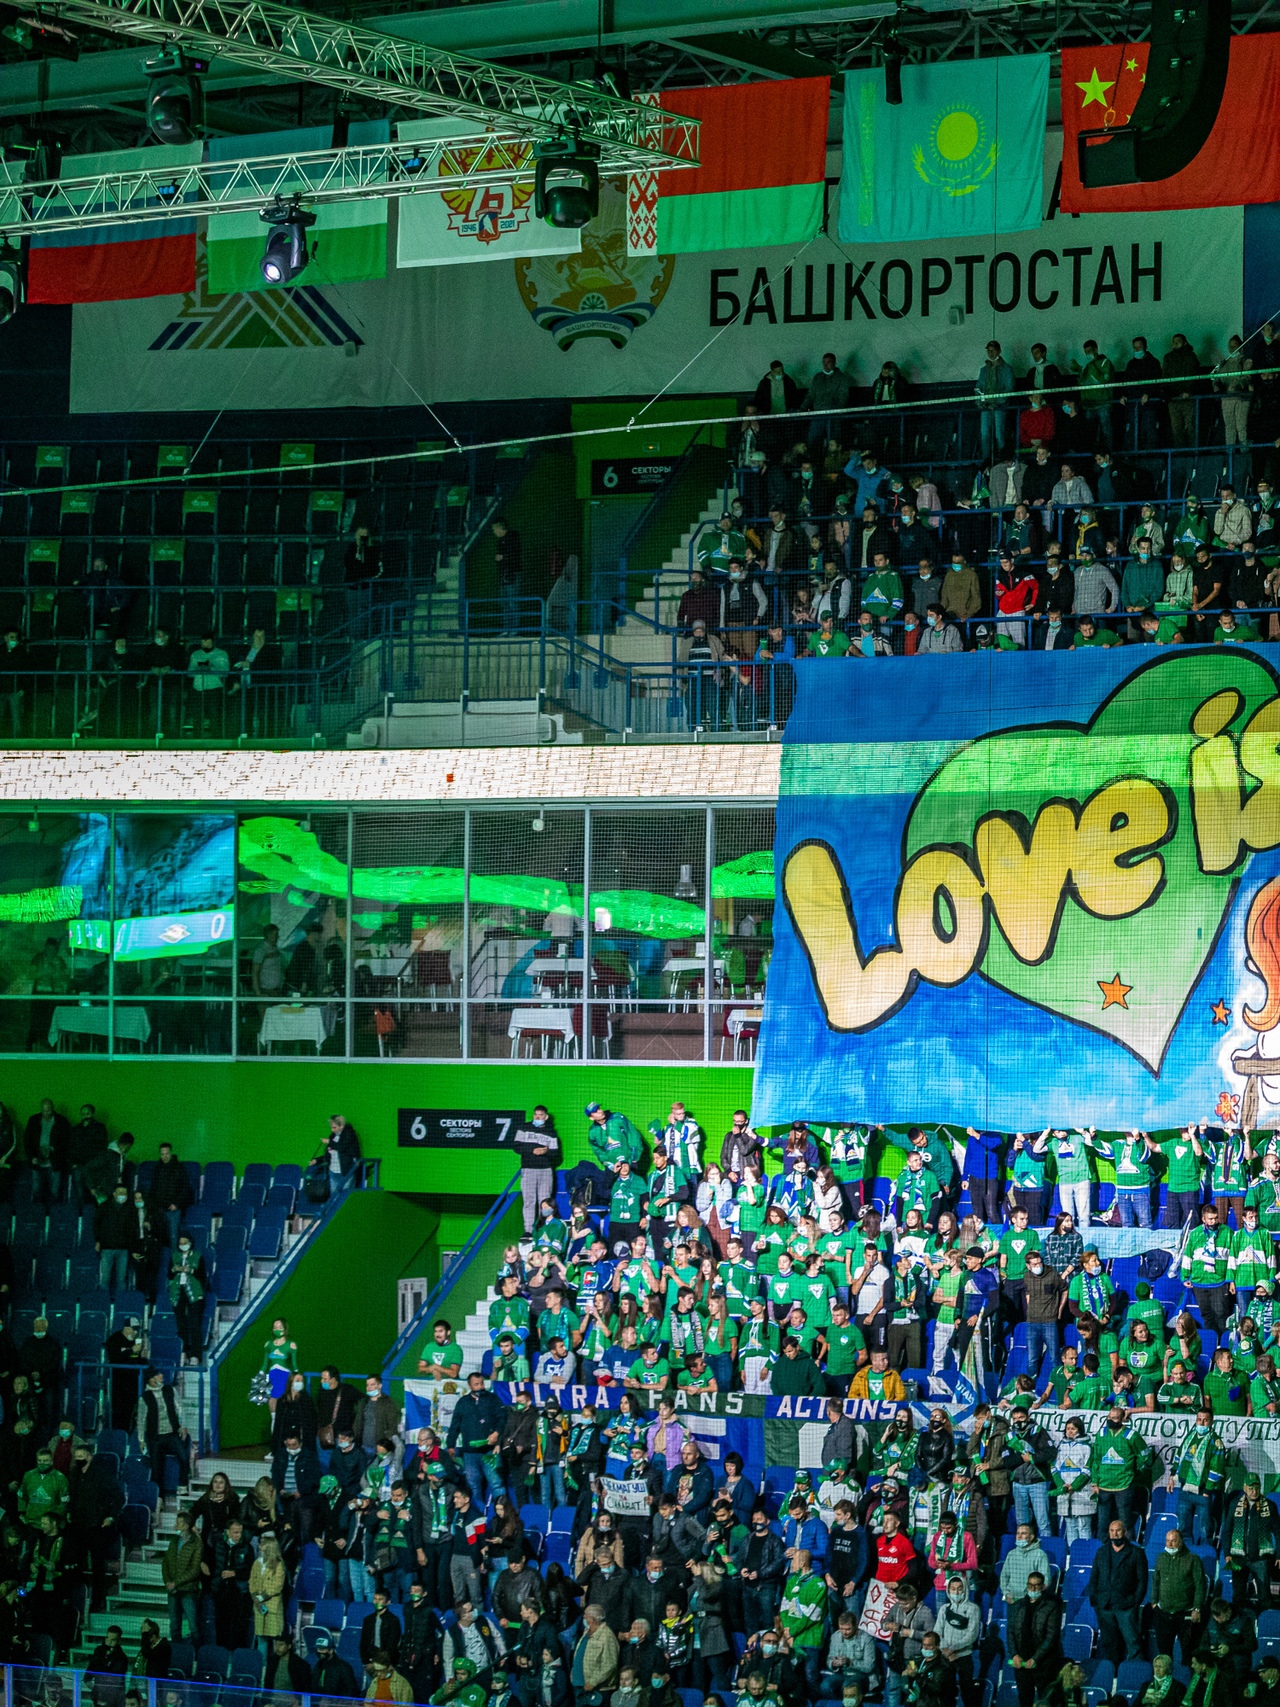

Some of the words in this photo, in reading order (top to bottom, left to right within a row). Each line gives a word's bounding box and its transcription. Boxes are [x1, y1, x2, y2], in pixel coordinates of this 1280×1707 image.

[461, 223, 476, 232] 1946
[709, 241, 1163, 327] БАШКОРТОСТАН
[603, 466, 619, 488] 6
[631, 466, 671, 474] СЕКТОРЫ
[783, 774, 1178, 1035] Love
[410, 1116, 427, 1140] 6
[440, 1119, 482, 1128] СЕКТОРЫ
[495, 1117, 512, 1141] 7
[509, 1382, 609, 1409] ULTRA
[649, 1389, 743, 1415] FANS
[776, 1395, 898, 1420] ACTONS
